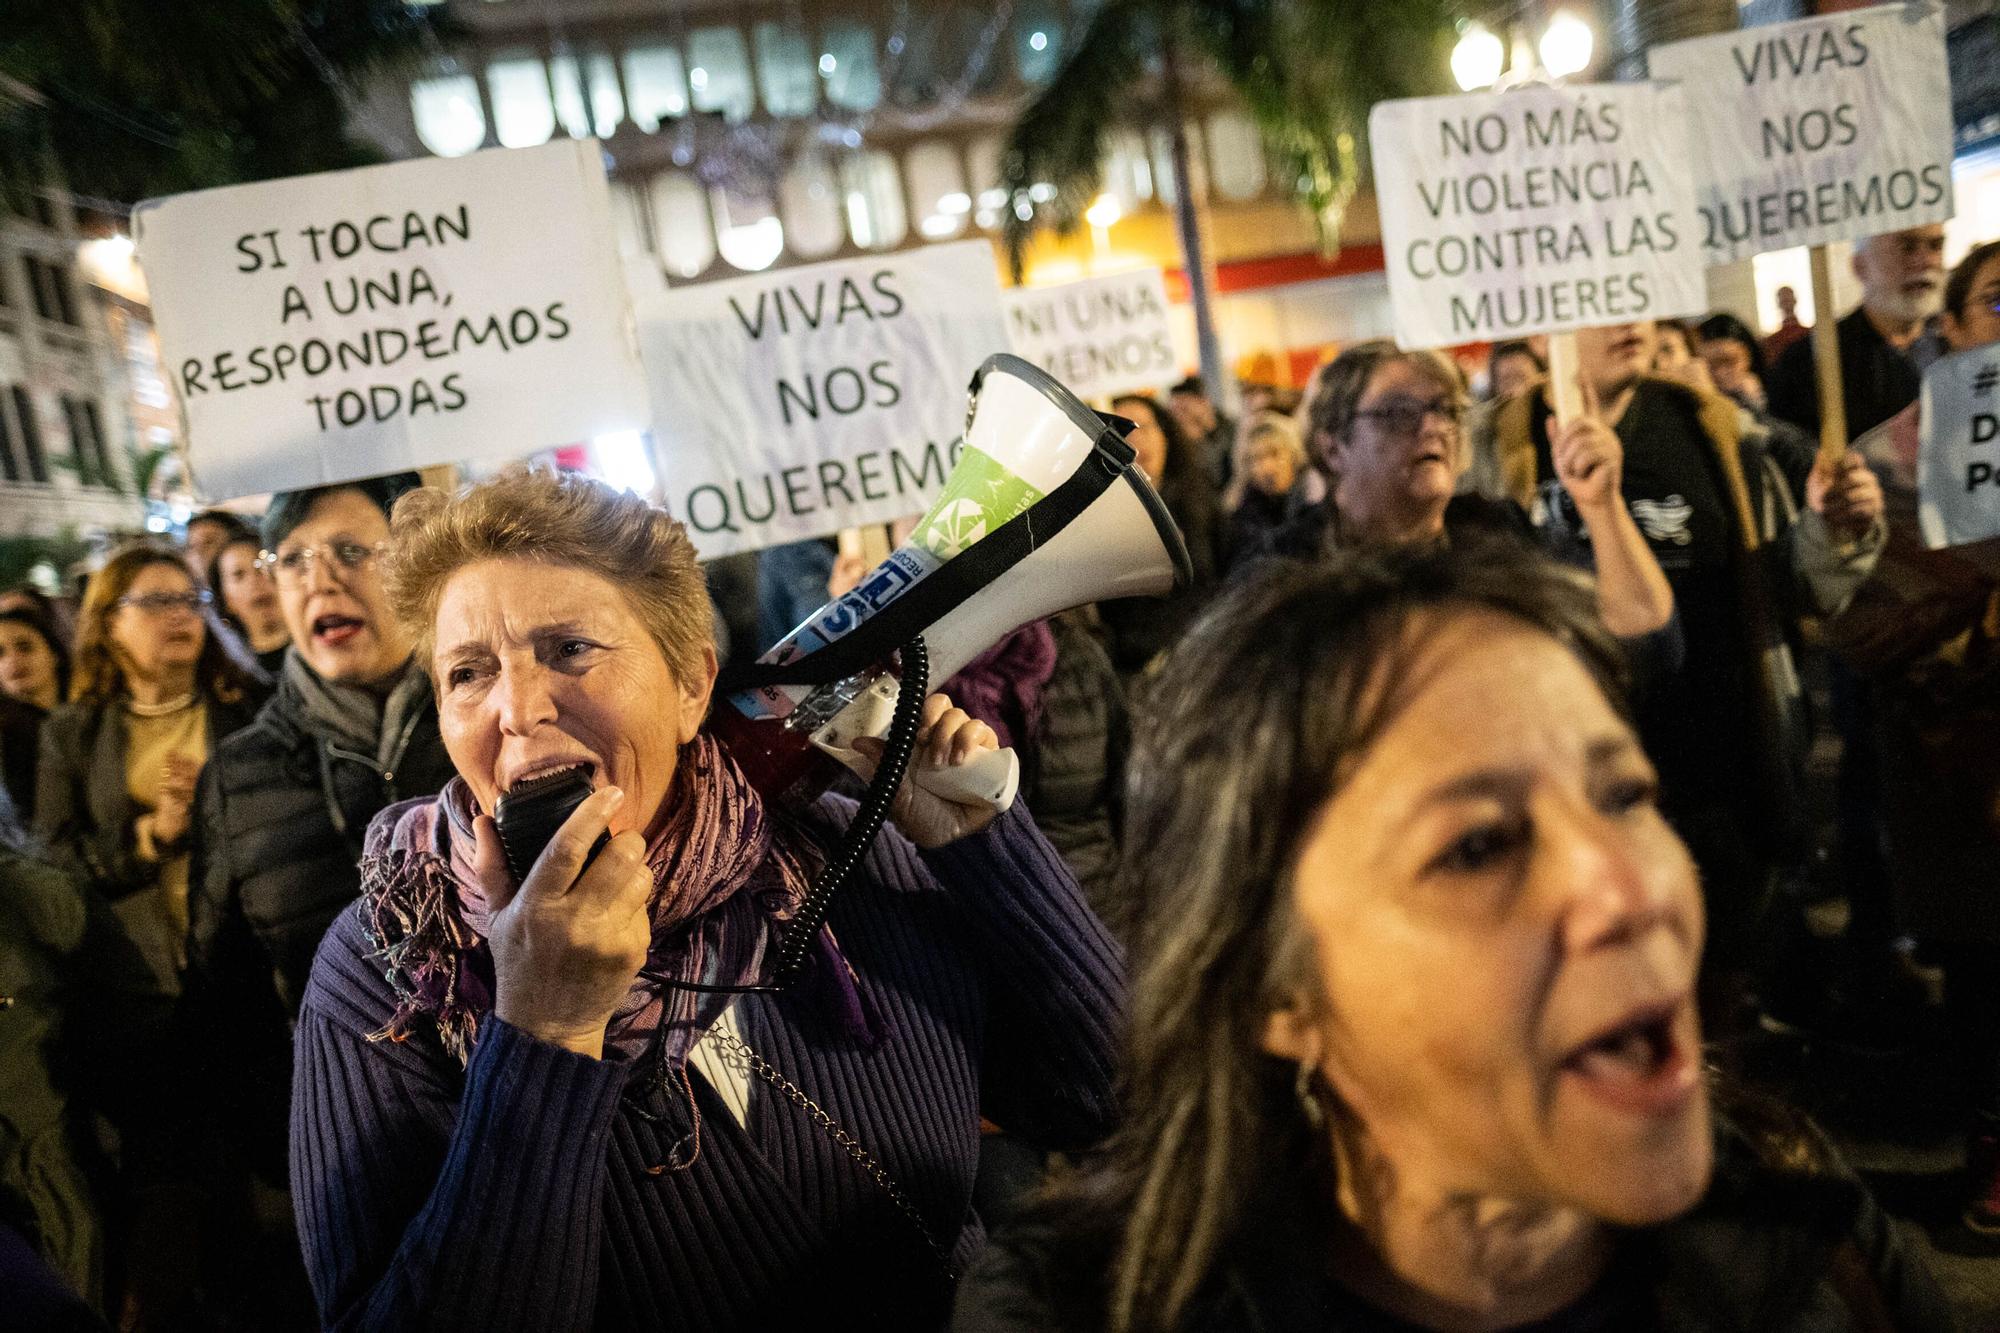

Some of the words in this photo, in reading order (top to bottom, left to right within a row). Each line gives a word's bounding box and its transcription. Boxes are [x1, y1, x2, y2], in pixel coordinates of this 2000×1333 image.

[1732, 24, 1868, 86] VIVAS
[1440, 113, 1508, 158] NO
[1524, 94, 1621, 149] MÁS
[1761, 104, 1859, 159] NOS
[1417, 160, 1655, 220] VIOLENCIA
[236, 233, 287, 273] SI
[301, 204, 471, 263] TOCAN
[1406, 226, 1593, 281] CONTRA
[1605, 213, 1678, 258] LAS
[281, 285, 311, 325] A
[326, 266, 454, 316] UNA,
[729, 270, 904, 341] VIVAS
[1011, 303, 1058, 338] NI
[1065, 285, 1166, 331] UNA
[1450, 272, 1651, 334] MUJERES
[182, 302, 570, 398] RESPONDEMOS
[307, 373, 467, 431] TODAS
[777, 360, 901, 426] NOS
